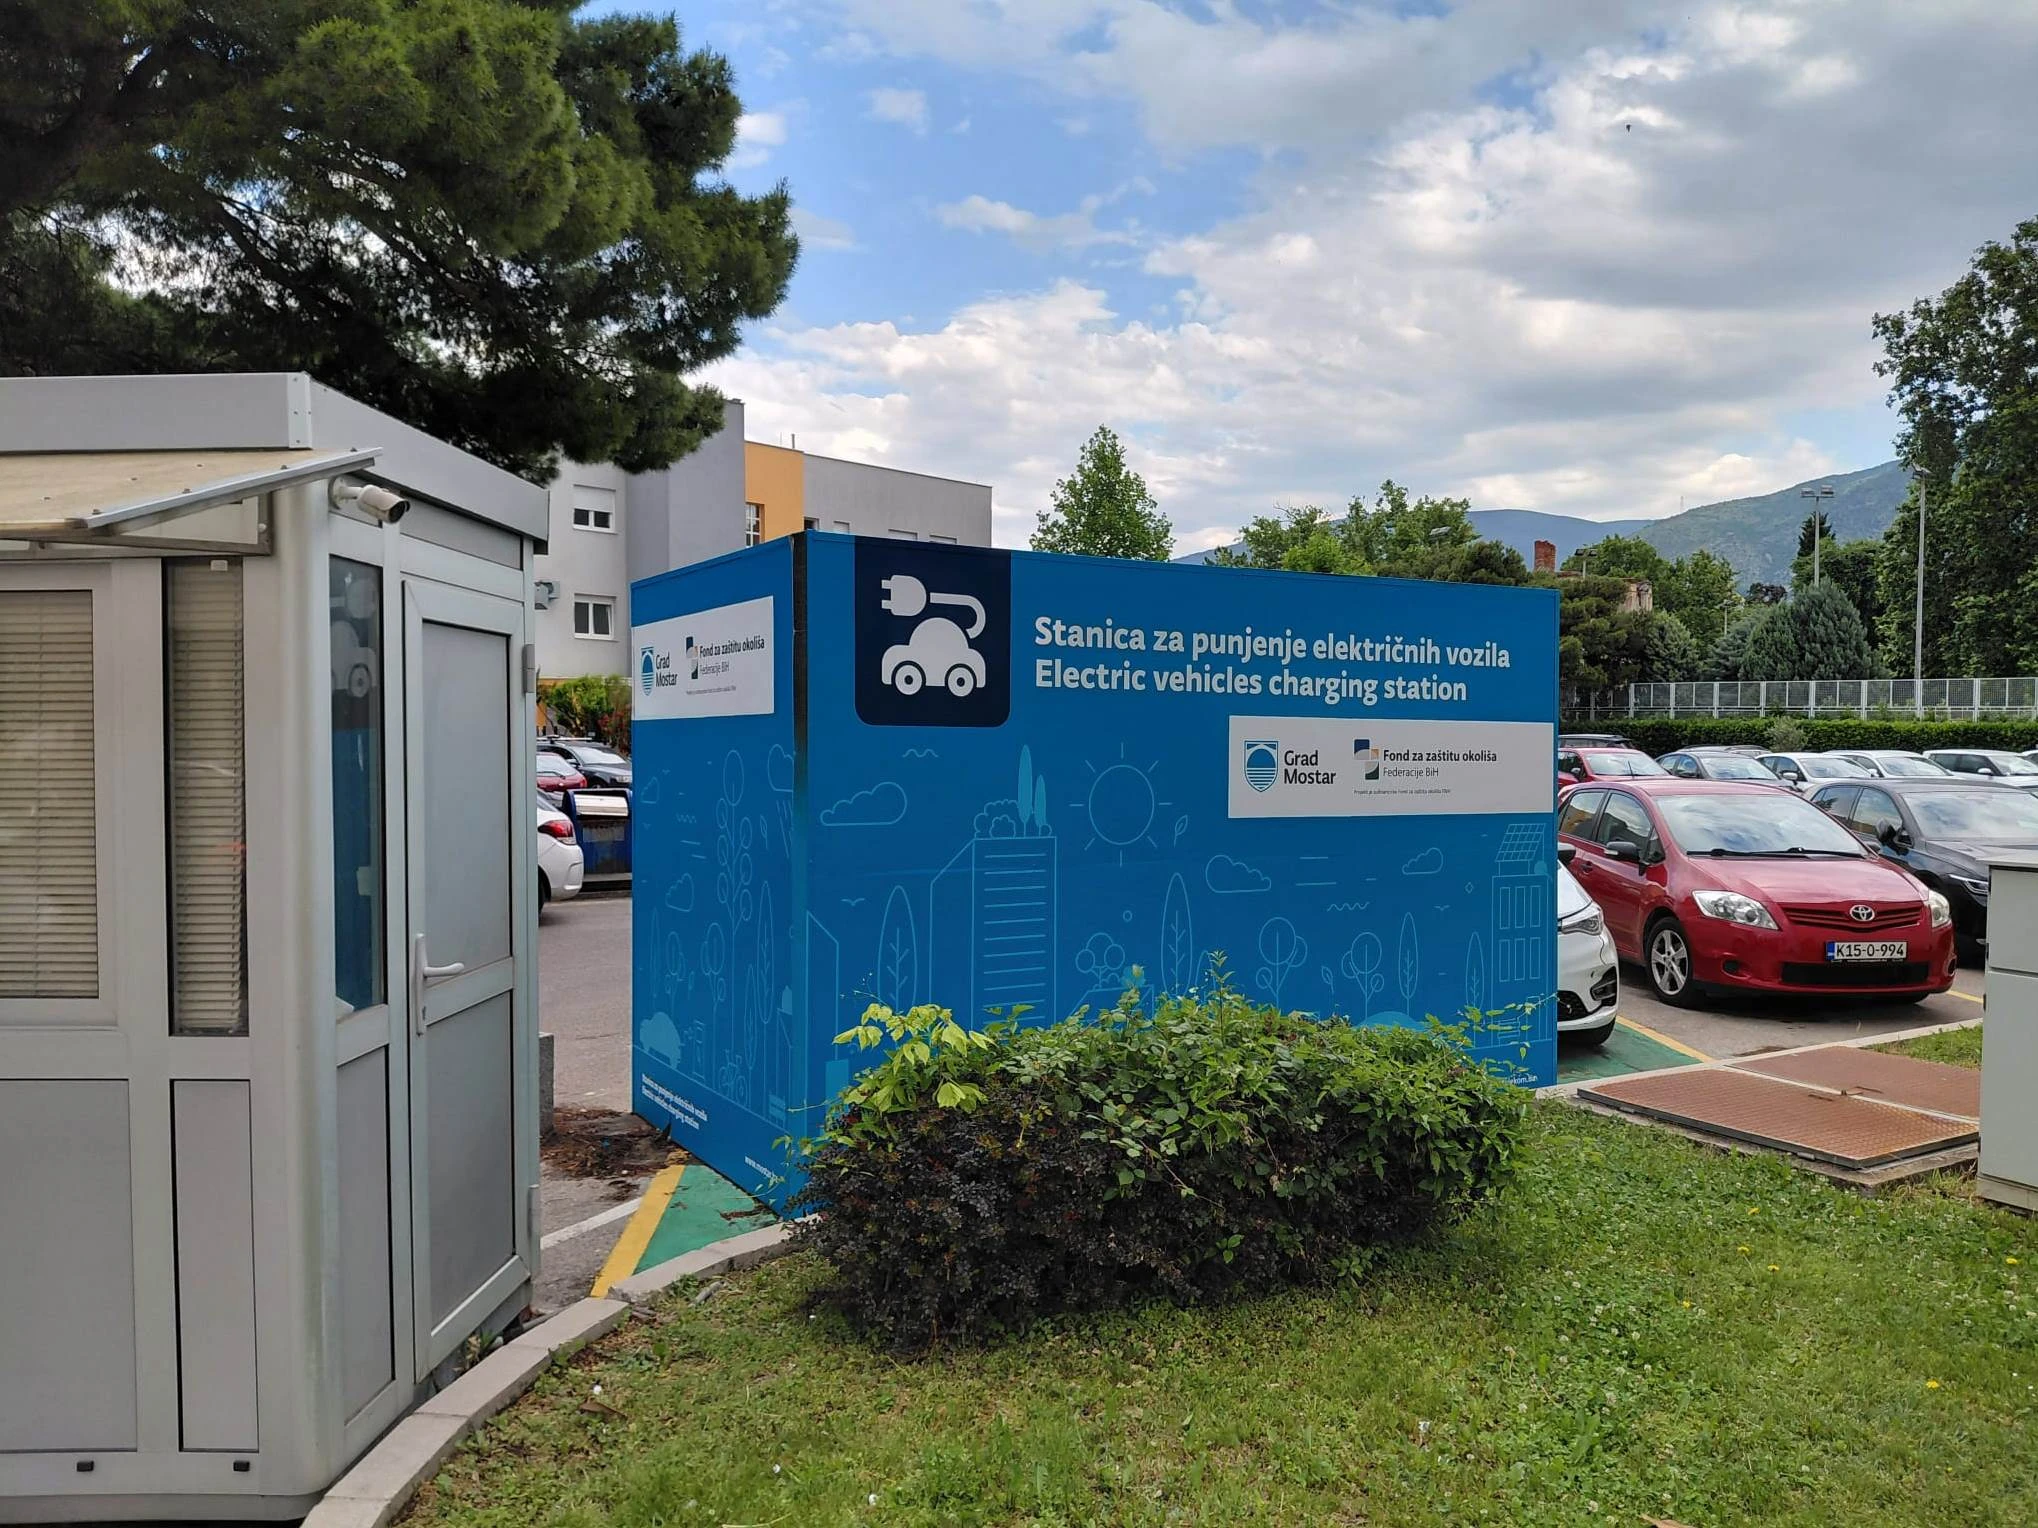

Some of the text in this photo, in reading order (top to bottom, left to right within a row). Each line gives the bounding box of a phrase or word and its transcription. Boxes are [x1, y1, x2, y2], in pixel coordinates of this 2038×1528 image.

[700, 643, 713, 658] Fond
[714, 644, 721, 656] za
[1035, 616, 1510, 668] Stanica za punjenje električnih vozila
[656, 651, 670, 670] Grad
[656, 671, 678, 687] Mostar
[1035, 658, 1467, 706] Electric vehicles charging station
[1284, 749, 1318, 766] Grad
[1383, 749, 1497, 762] Fond za zaštitu okoliša
[1284, 768, 1337, 785] Mostar
[1383, 766, 1439, 779] Federacije BiH
